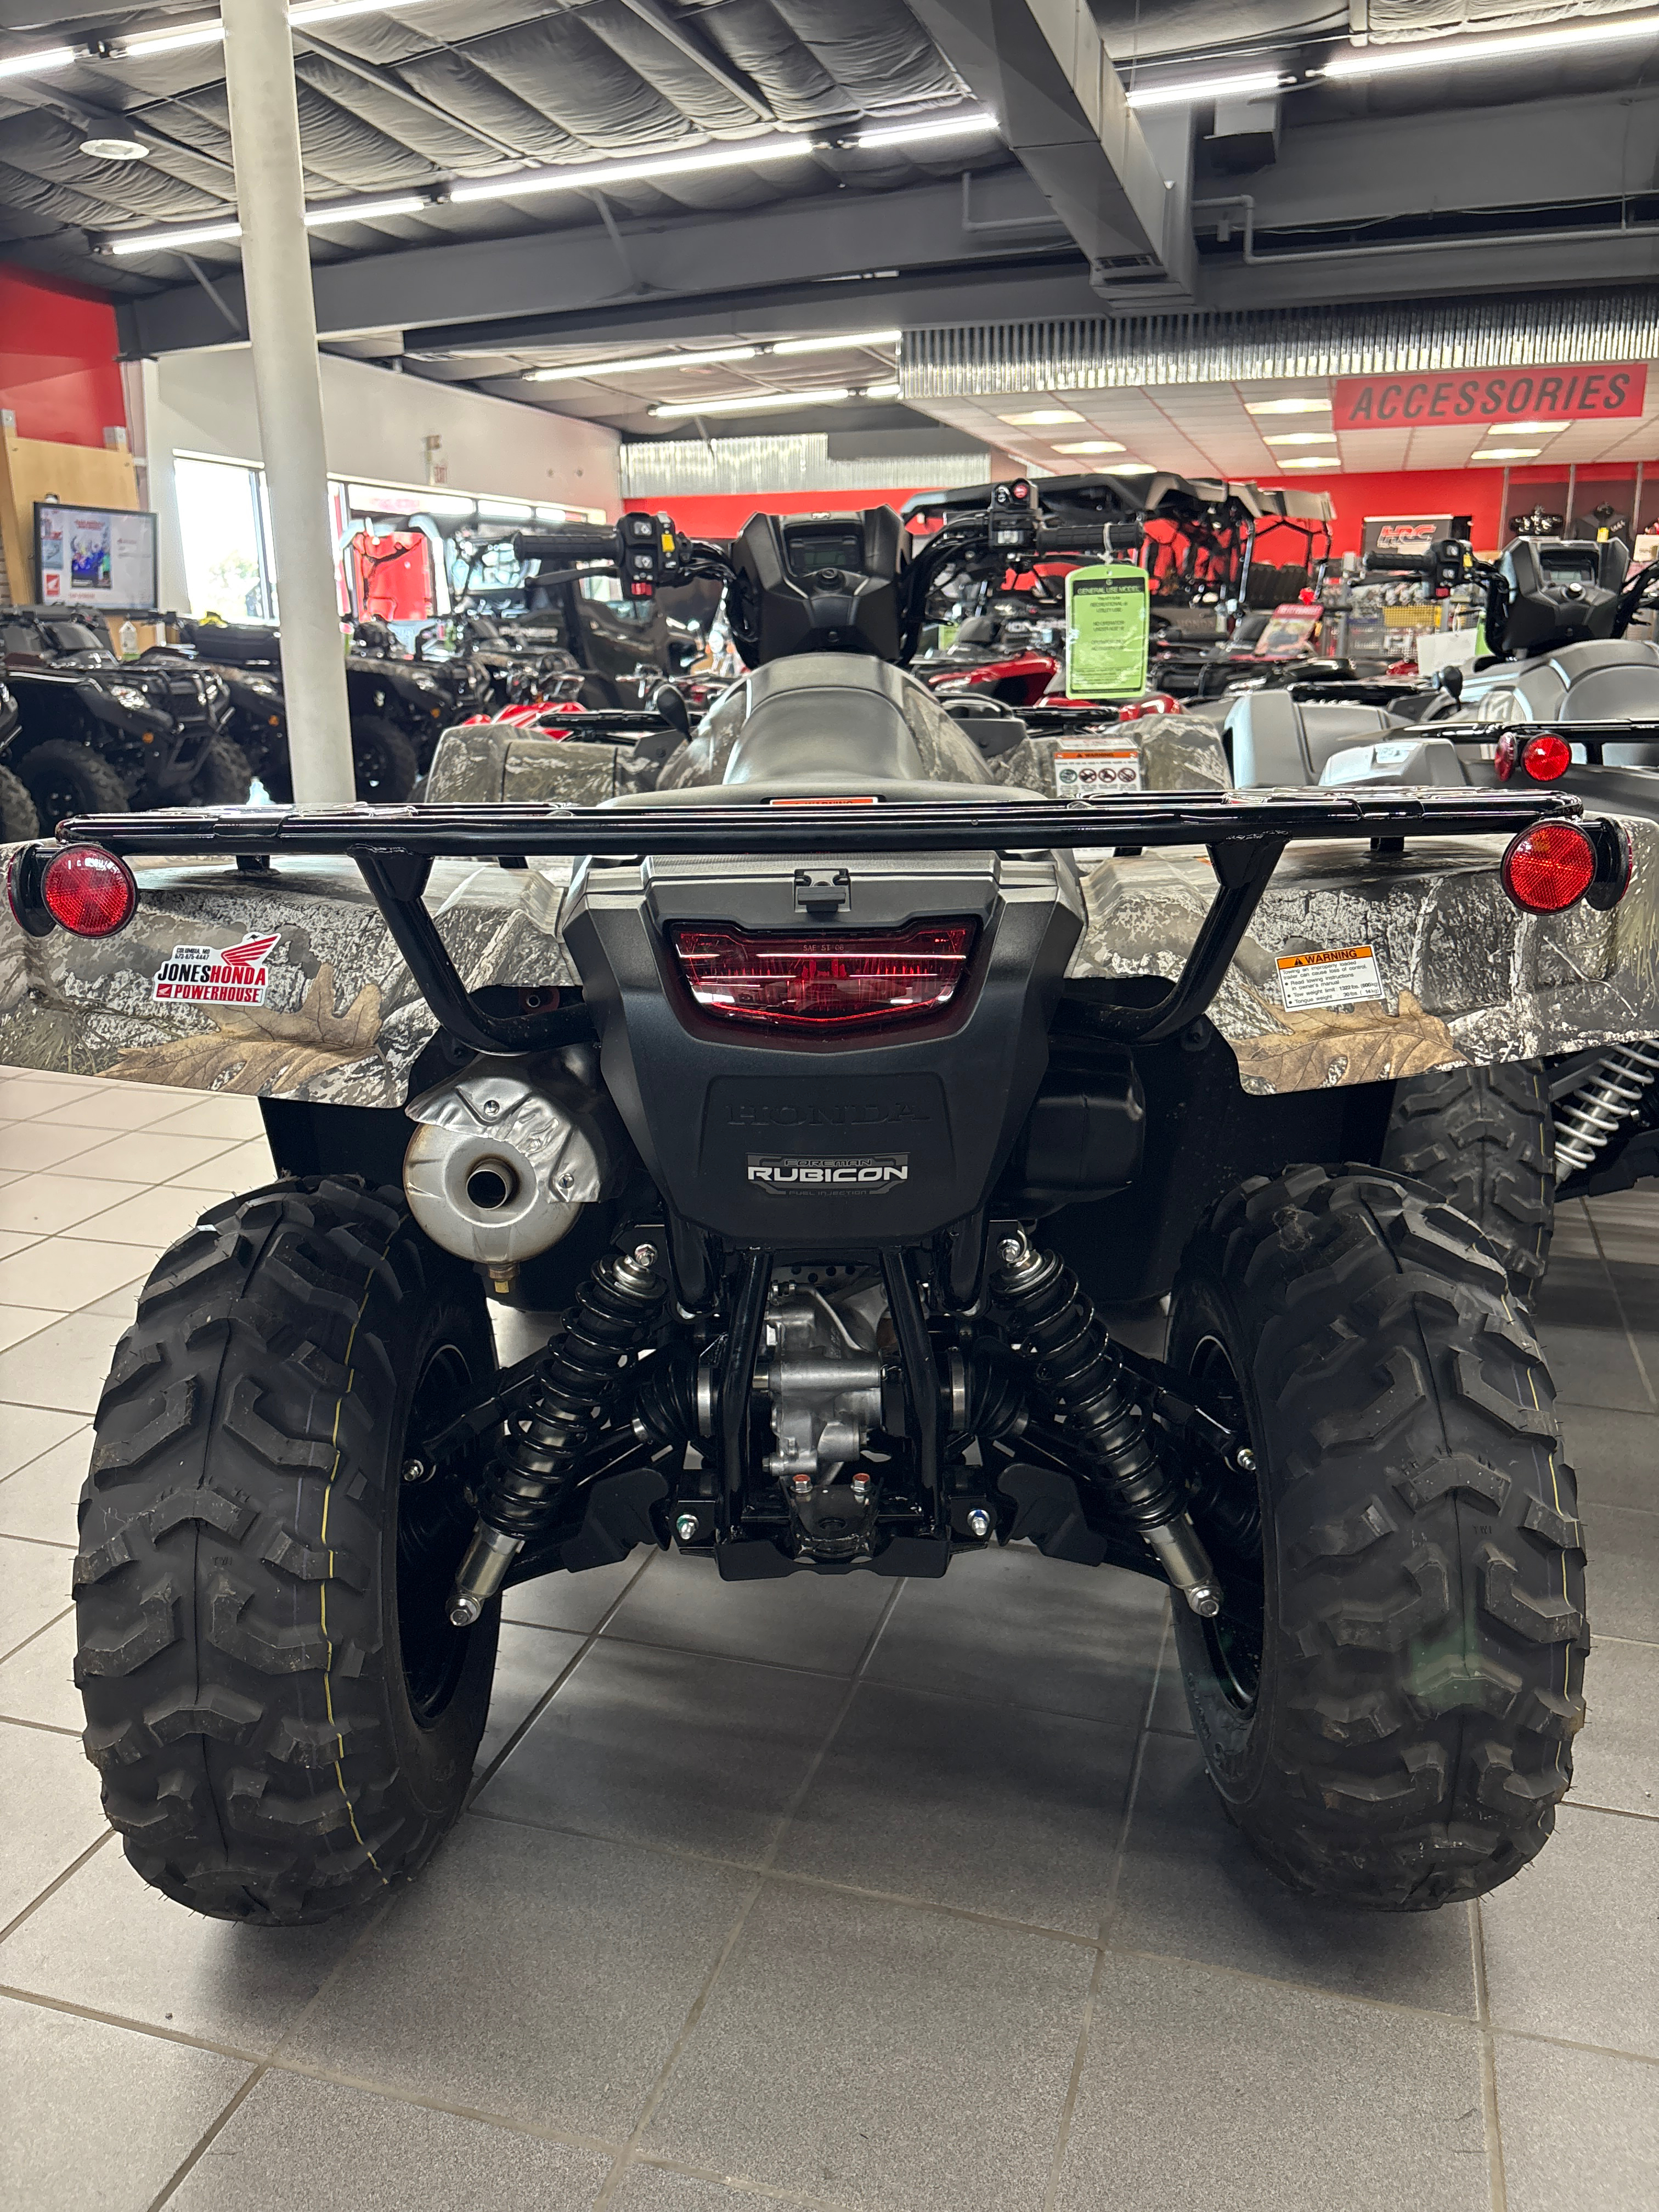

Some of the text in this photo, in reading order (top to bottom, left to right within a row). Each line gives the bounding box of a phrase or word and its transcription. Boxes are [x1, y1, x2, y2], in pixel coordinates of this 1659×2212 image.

[1348, 373, 1630, 422] ACCESSORIES
[1377, 524, 1437, 549] HRC
[1077, 587, 1105, 595] GENERAL
[1119, 585, 1141, 593] MODEL
[1305, 950, 1357, 964] WARNING
[174, 984, 261, 1002] POWERHOUSE
[726, 1103, 930, 1126] HONDA
[785, 1158, 872, 1167] FOREMAN
[747, 1165, 909, 1182] RUBICON
